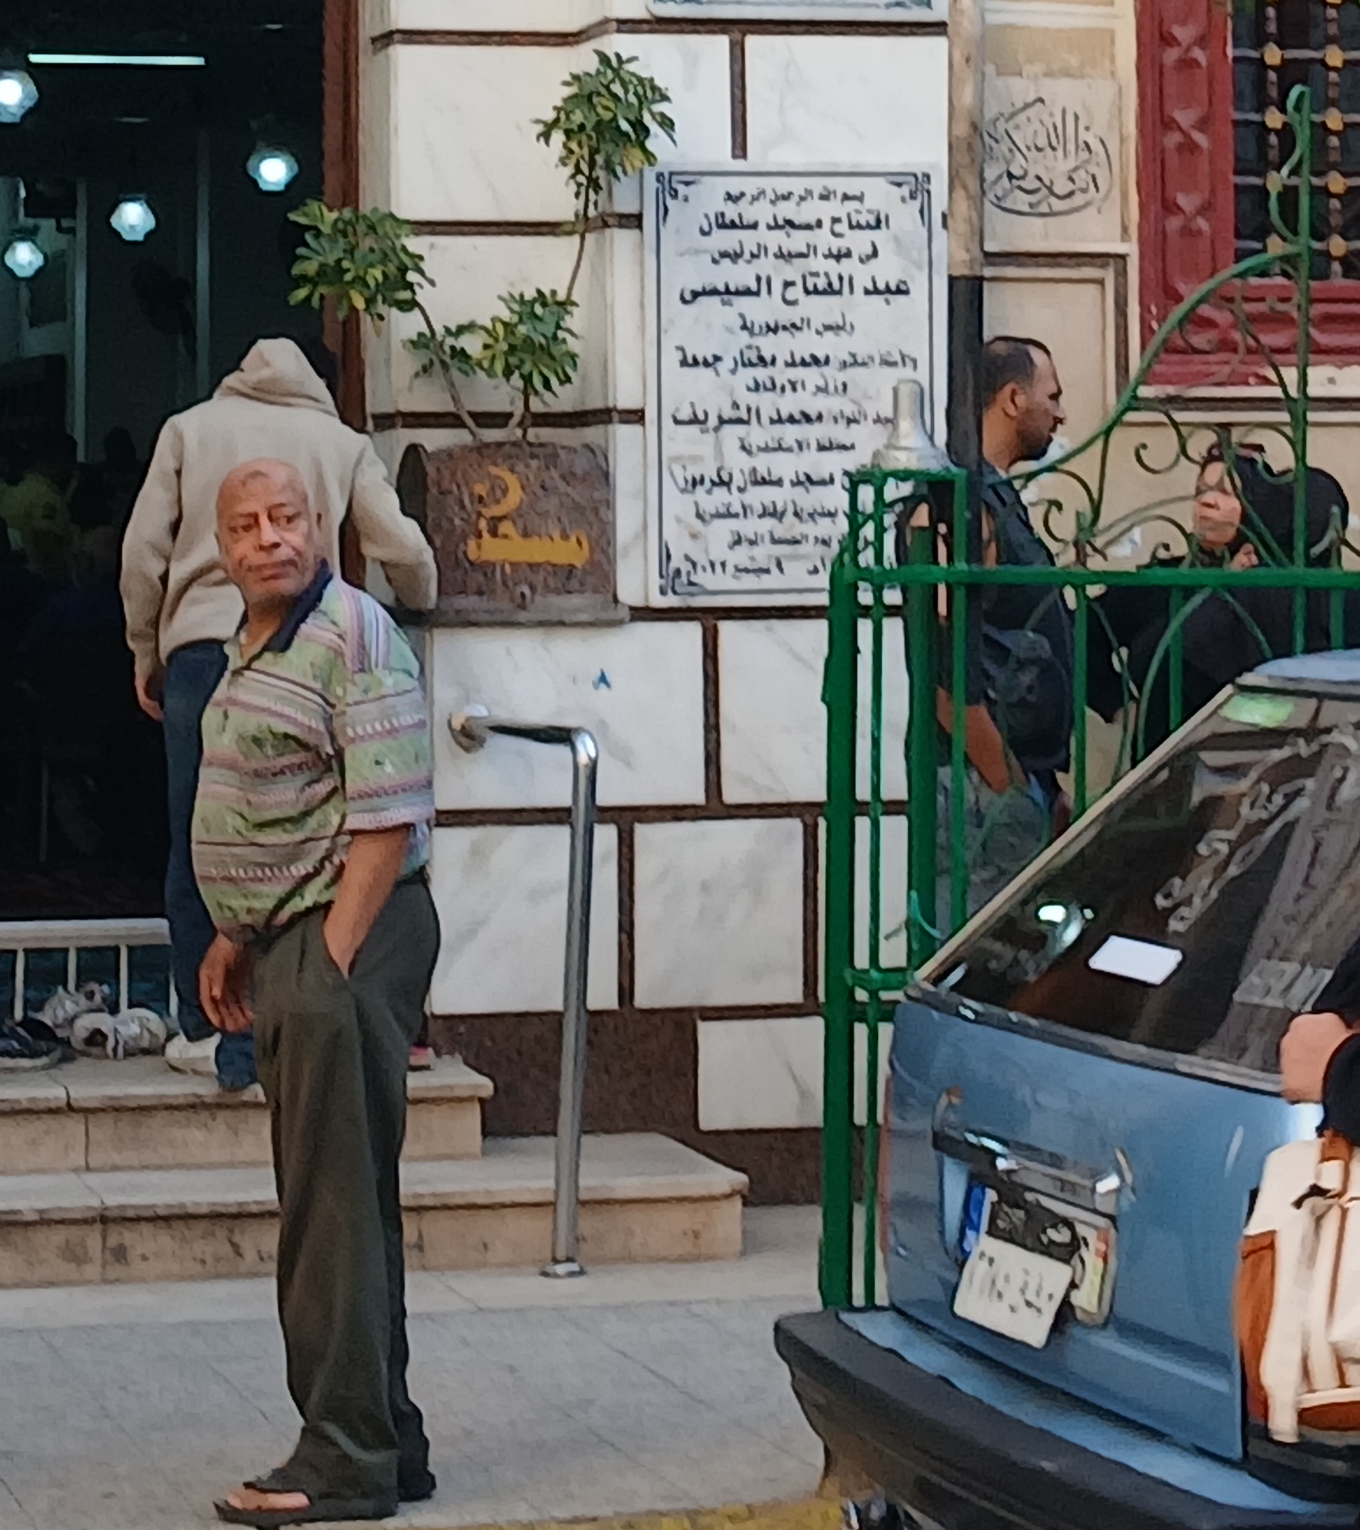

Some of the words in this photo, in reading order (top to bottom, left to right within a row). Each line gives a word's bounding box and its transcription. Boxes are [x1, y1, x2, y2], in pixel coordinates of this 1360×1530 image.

[765, 212, 824, 239] مسجد
[780, 270, 855, 307] الفتاح
[862, 274, 911, 307] عبد
[768, 407, 824, 426] محمد
